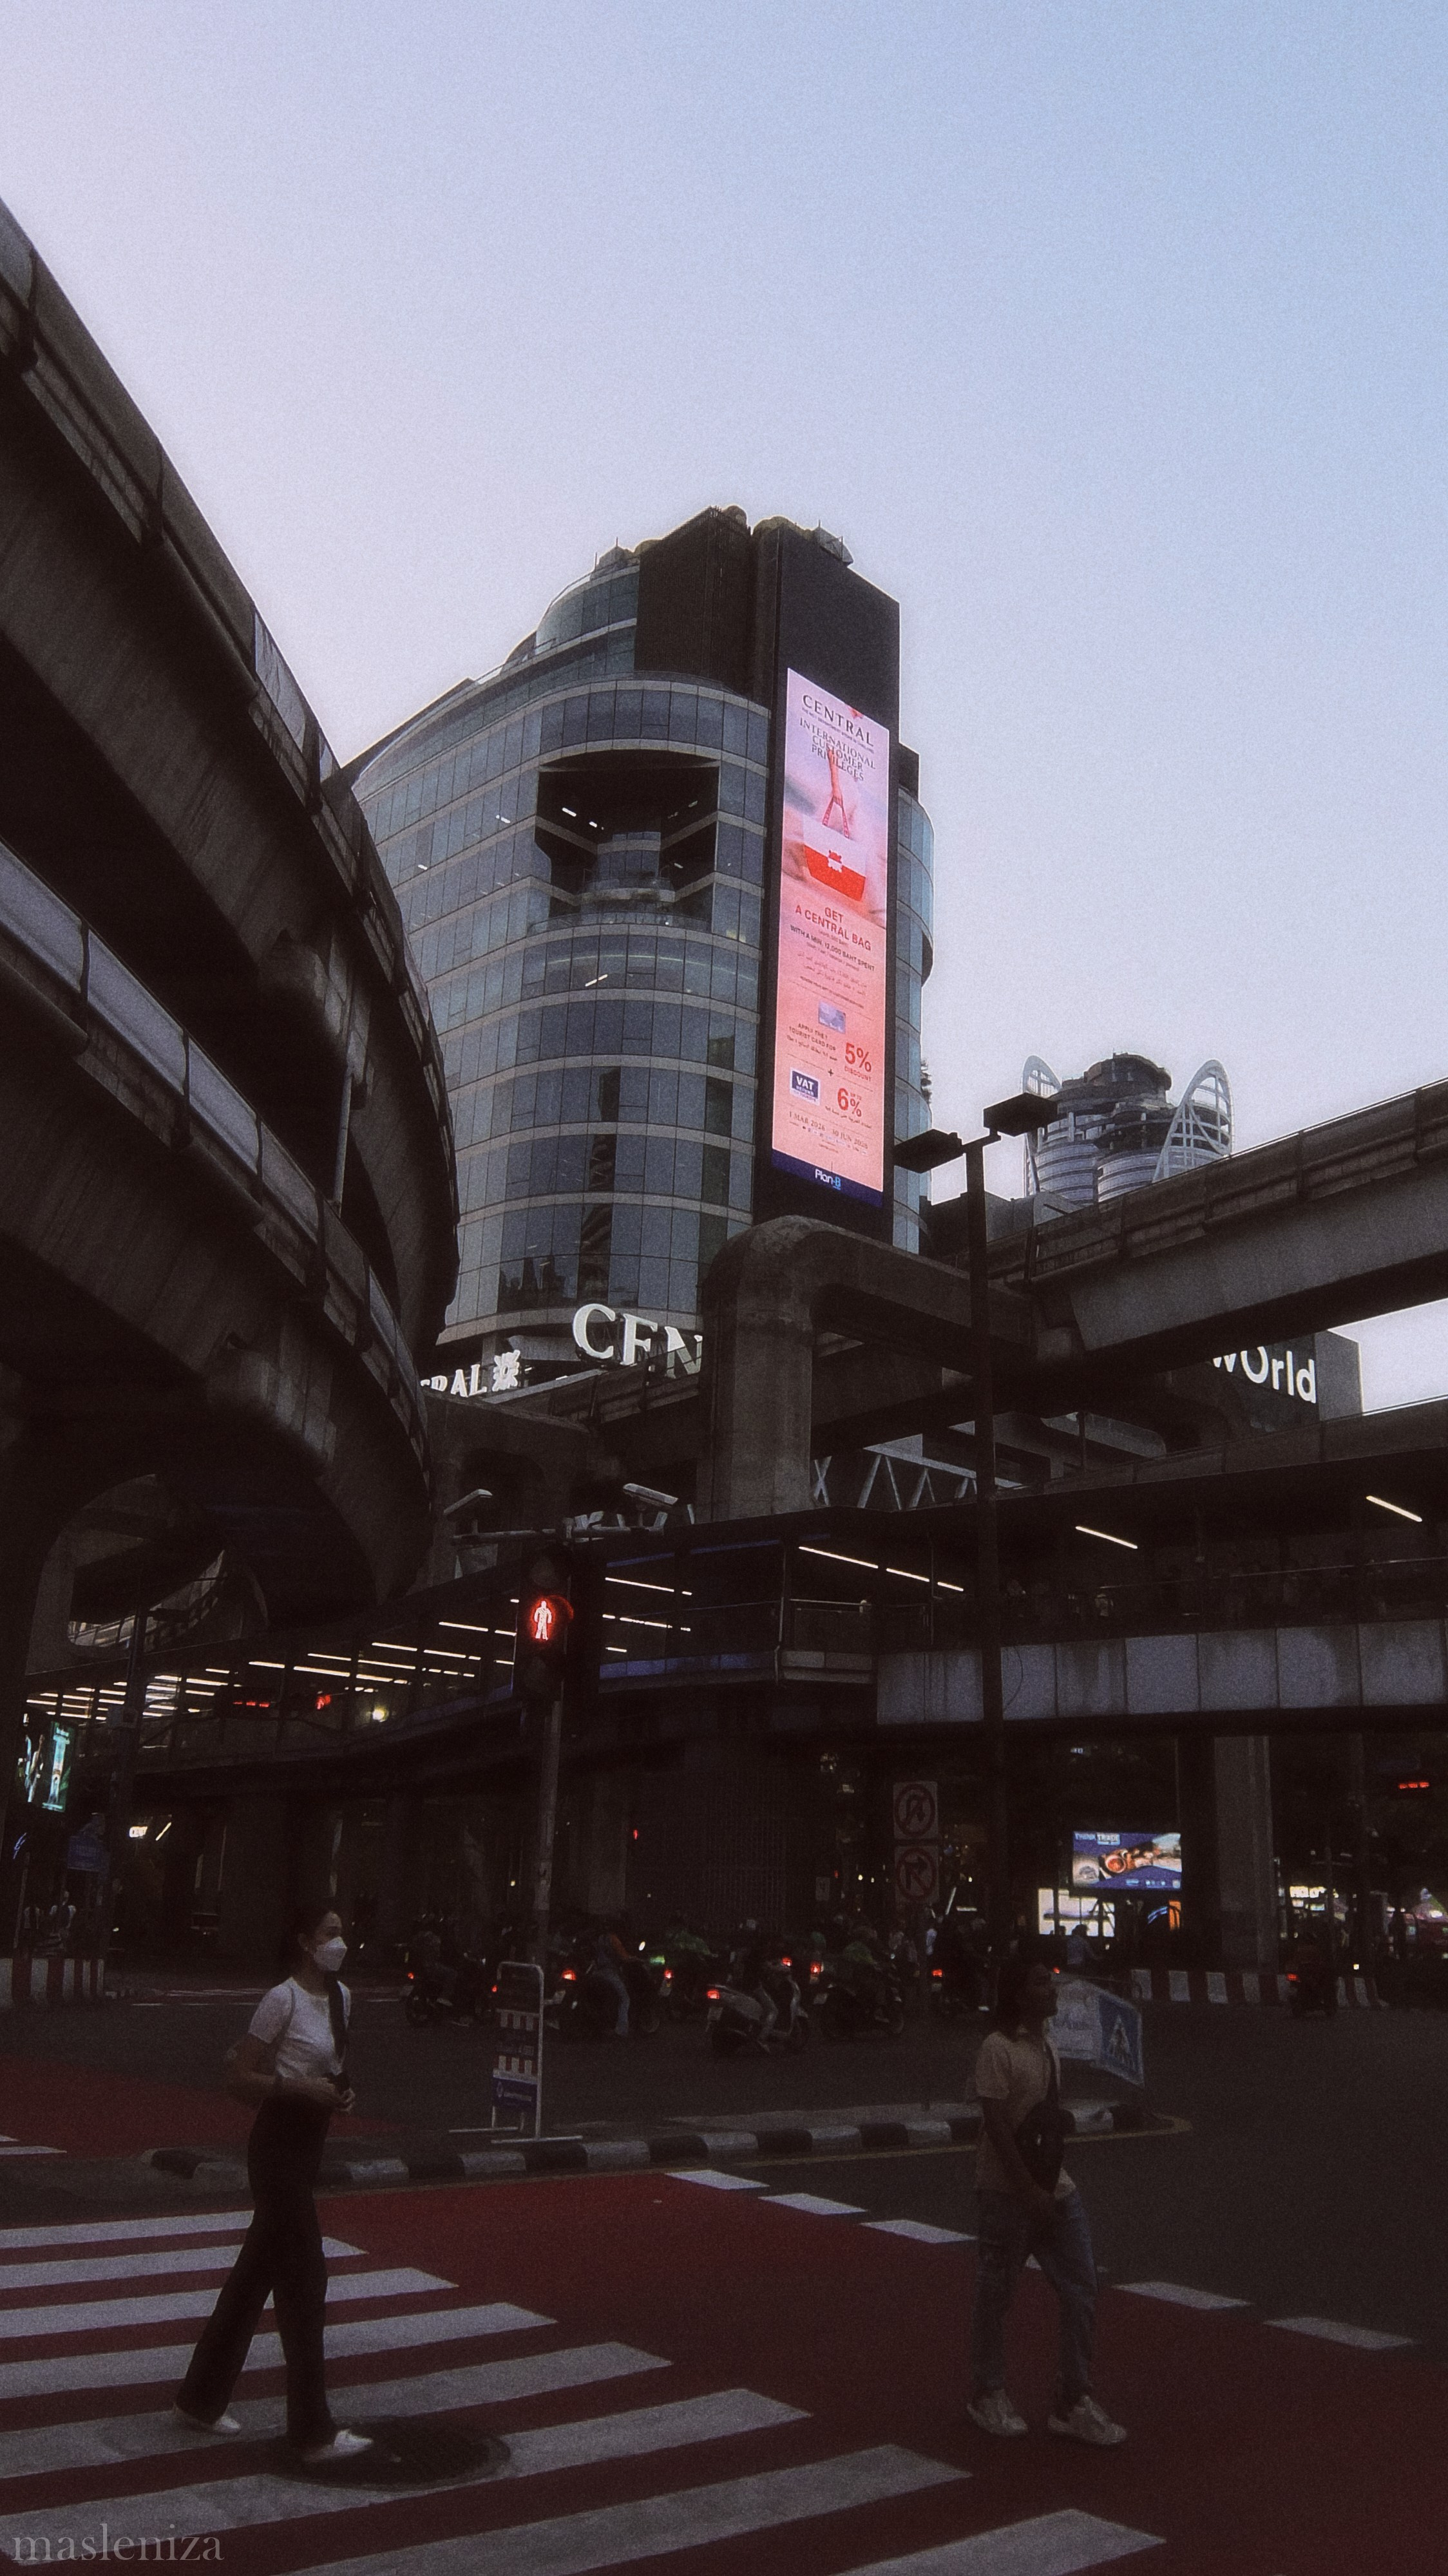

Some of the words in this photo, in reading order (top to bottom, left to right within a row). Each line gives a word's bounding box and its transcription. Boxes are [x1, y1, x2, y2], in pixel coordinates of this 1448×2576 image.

[803, 695, 873, 747] CENTRAL
[799, 717, 875, 770] INTERNATIONAL
[812, 735, 863, 772] CUSTOMER
[795, 905, 801, 914] A
[805, 909, 849, 940] CENTRAL
[852, 933, 871, 951] BAG
[824, 907, 843, 923] GET
[790, 924, 805, 936] WITH
[842, 951, 857, 962] BAHT
[857, 959, 875, 971] SPENT
[789, 1026, 810, 1039] TOURIST
[811, 1036, 825, 1046] CARD
[844, 1042, 872, 1072] 5%
[796, 1075, 814, 1090] VAT
[844, 1066, 872, 1082] DISCOUNT
[837, 1088, 862, 1117] 6%
